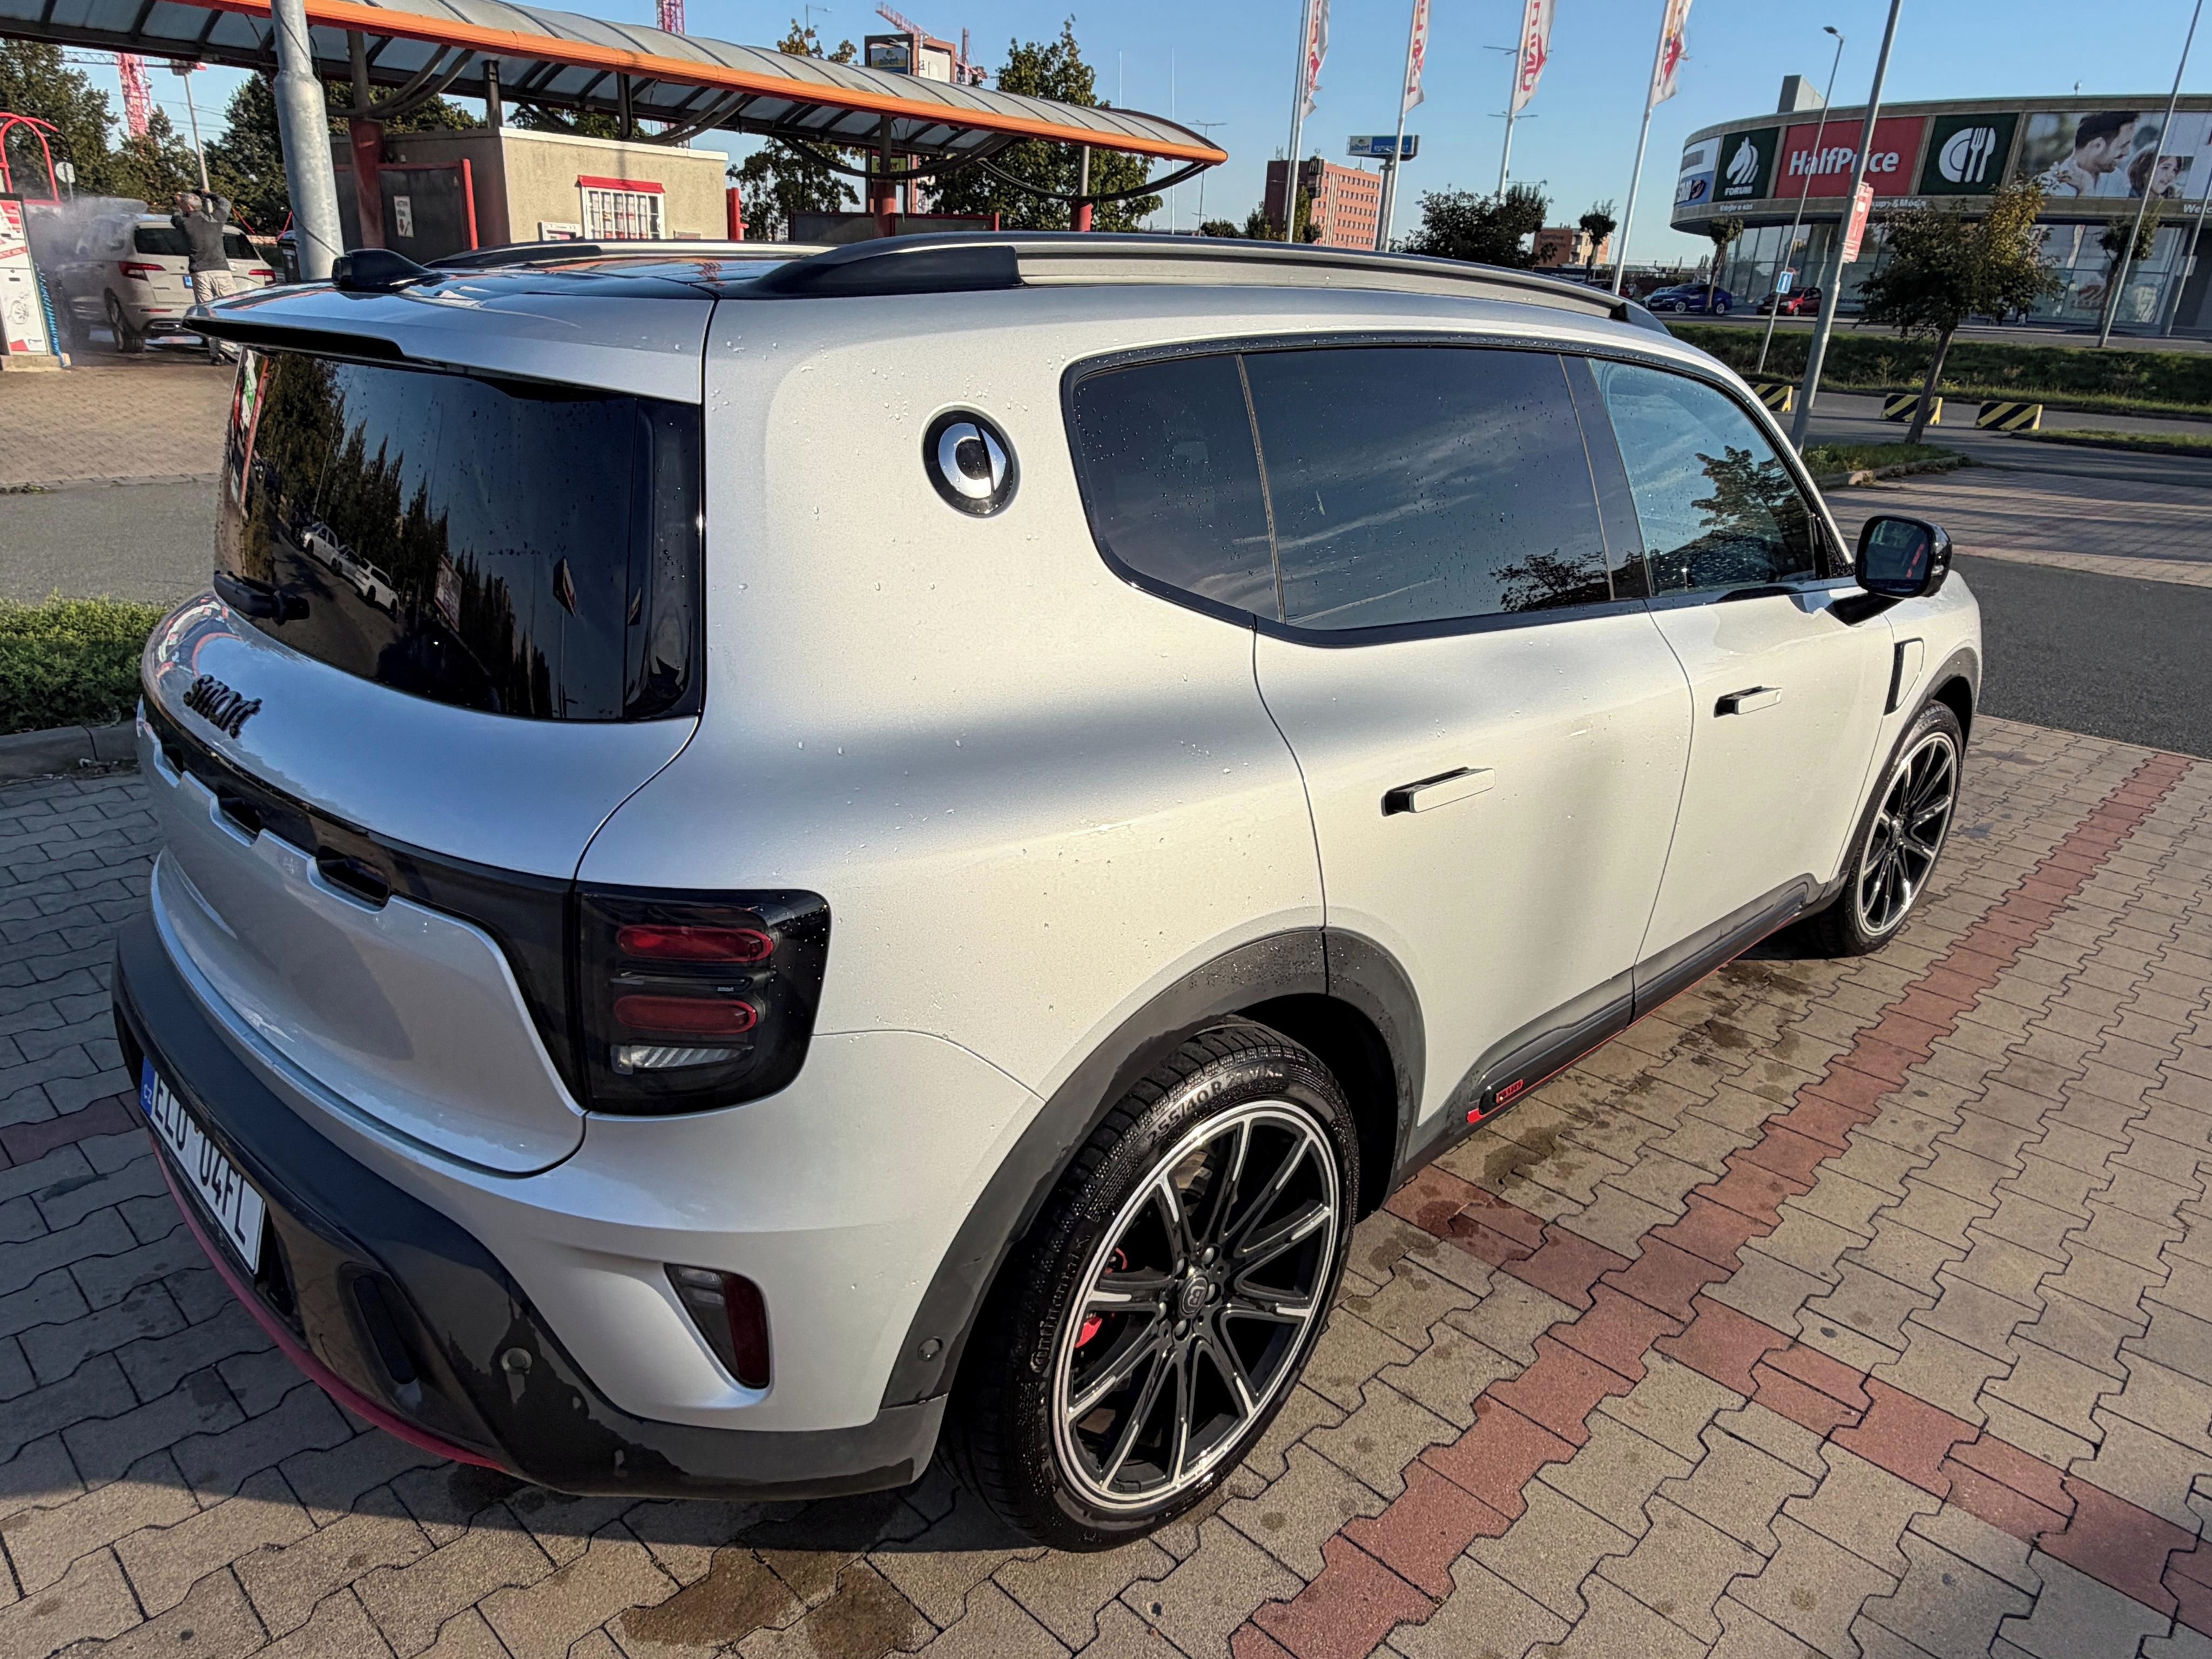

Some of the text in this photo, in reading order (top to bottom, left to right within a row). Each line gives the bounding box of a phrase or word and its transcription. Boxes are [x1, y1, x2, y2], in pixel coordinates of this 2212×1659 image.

[1788, 147, 1900, 176] HalfPrce
[1724, 186, 1753, 196] FORUM
[183, 674, 263, 739] smart
[143, 1083, 152, 1105] CZ
